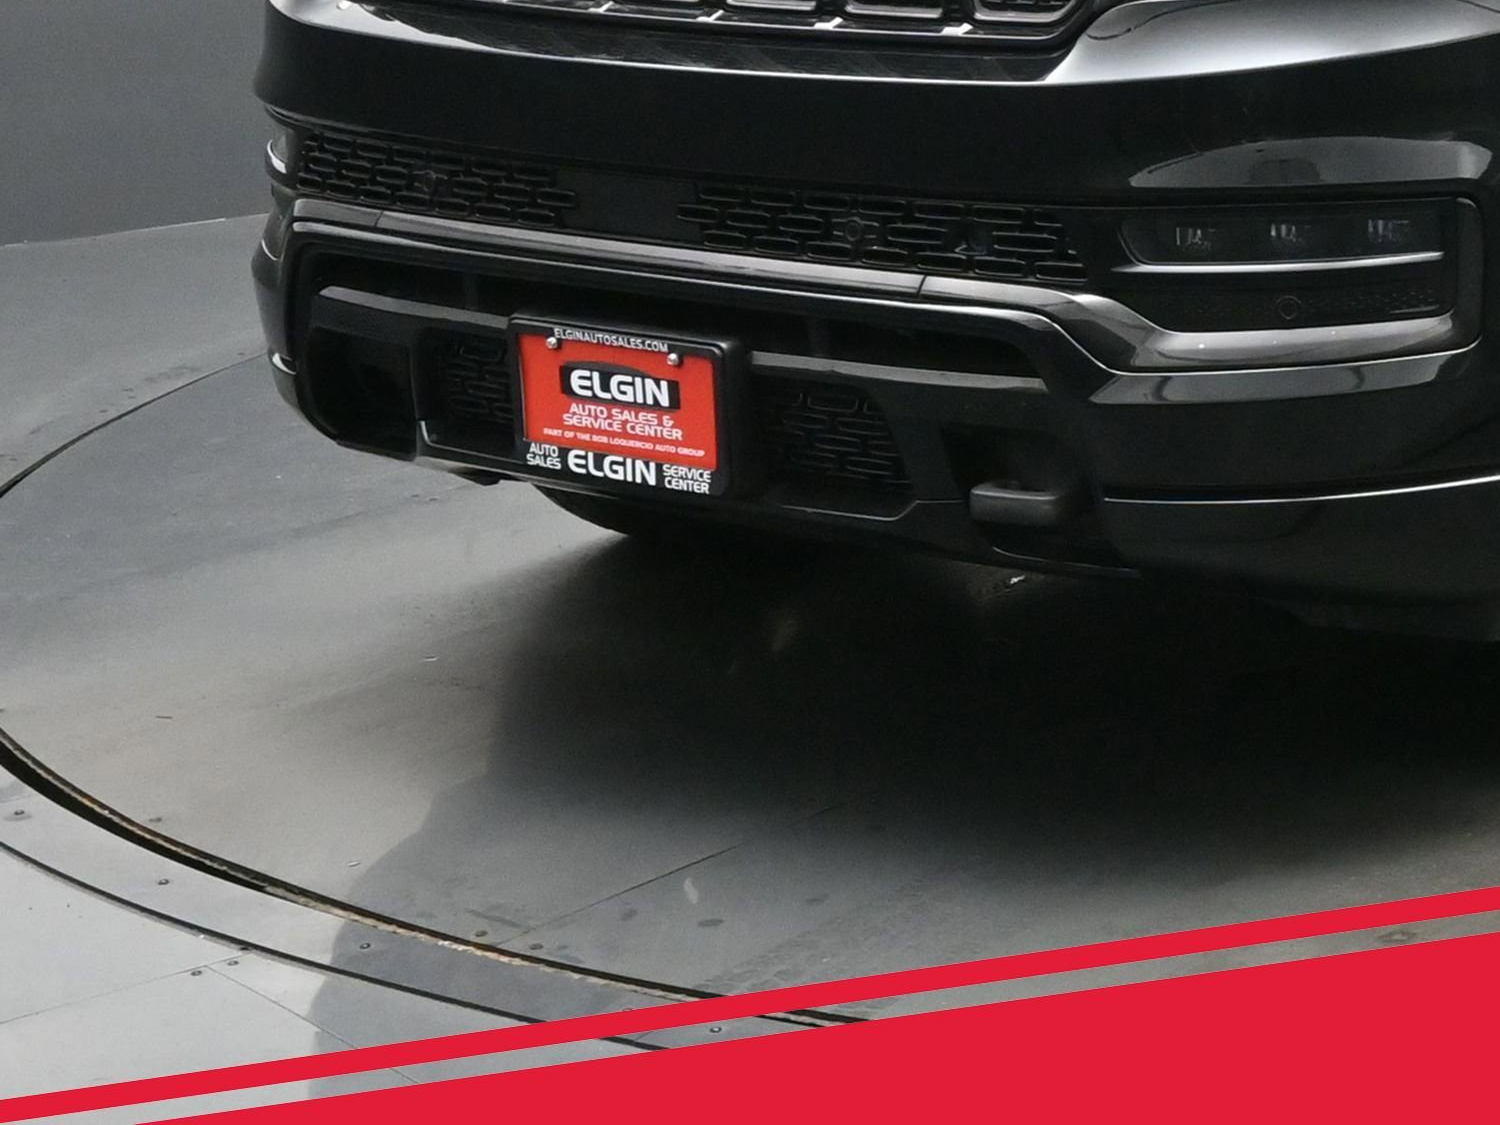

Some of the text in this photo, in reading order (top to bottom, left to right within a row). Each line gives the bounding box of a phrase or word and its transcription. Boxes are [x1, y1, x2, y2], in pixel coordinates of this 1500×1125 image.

[553, 327, 669, 353] ELGINAUTOSALES.COM
[570, 368, 670, 408] ELGIN
[562, 413, 683, 441] SERVICE CENTER
[569, 402, 674, 427] AUTO SALES &
[529, 442, 558, 458] AUTO
[543, 427, 563, 437] PART
[576, 432, 591, 441] THE
[592, 434, 609, 444] BOB
[609, 437, 654, 451] LOQUERCIO
[655, 443, 677, 454] AUTO
[677, 446, 706, 458] GROUP
[526, 453, 562, 471] SALES
[567, 449, 657, 486] ELGIN
[662, 463, 712, 483] SERVICE
[664, 475, 710, 495] CENTER
